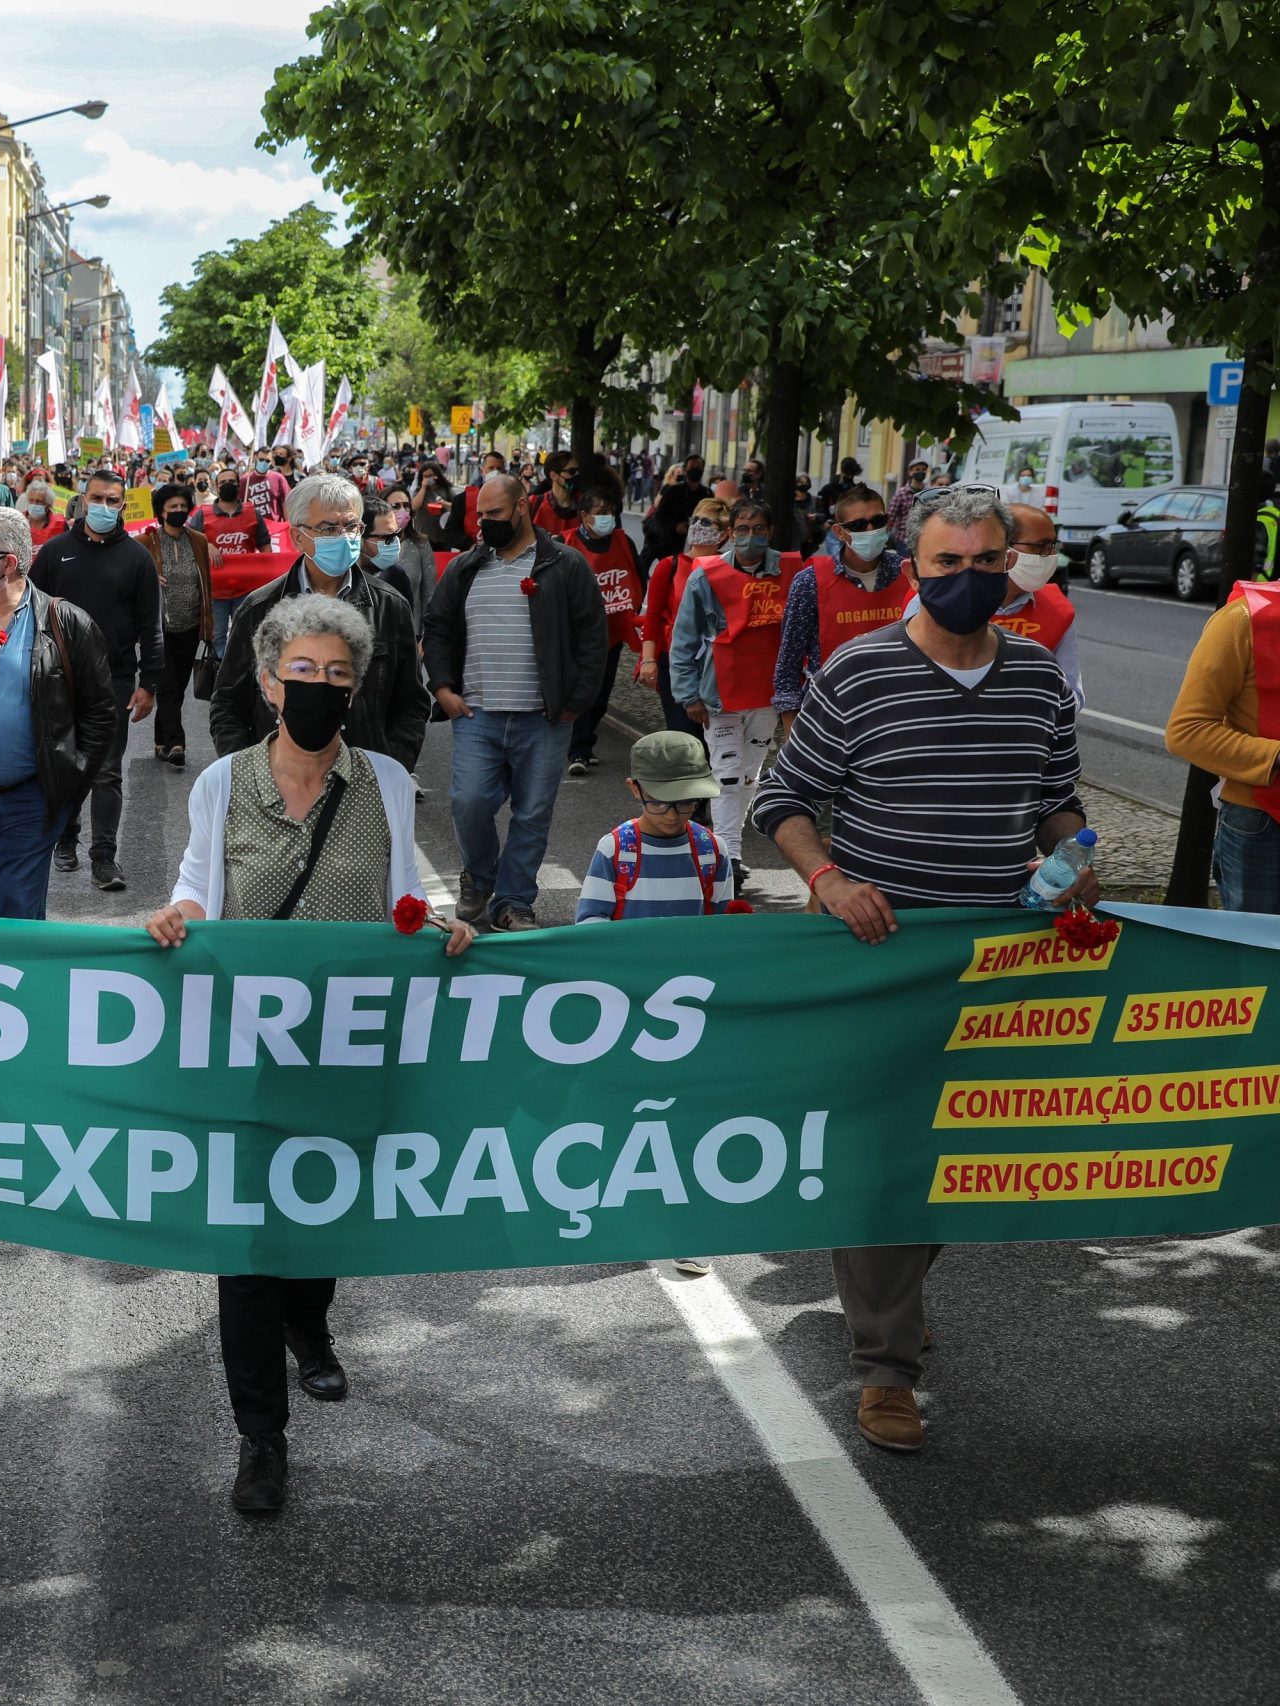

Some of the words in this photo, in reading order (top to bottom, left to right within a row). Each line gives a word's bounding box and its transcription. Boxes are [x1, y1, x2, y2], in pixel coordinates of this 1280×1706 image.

[1219, 367, 1244, 399] P
[249, 481, 271, 496] YES!
[215, 532, 249, 545] CGTP
[595, 569, 628, 586] GTP
[67, 968, 716, 1068] DIREITOS
[959, 1001, 1091, 1041] SALÁRIOS
[1127, 1003, 1160, 1032] 35
[1165, 996, 1253, 1030] HORAS
[947, 1077, 1152, 1124] CONTRATAÇÃO
[1159, 1074, 1280, 1113] COLECTIV
[942, 1161, 1078, 1200] SERVIÇOS
[1086, 1152, 1217, 1191] PÚBLICOS
